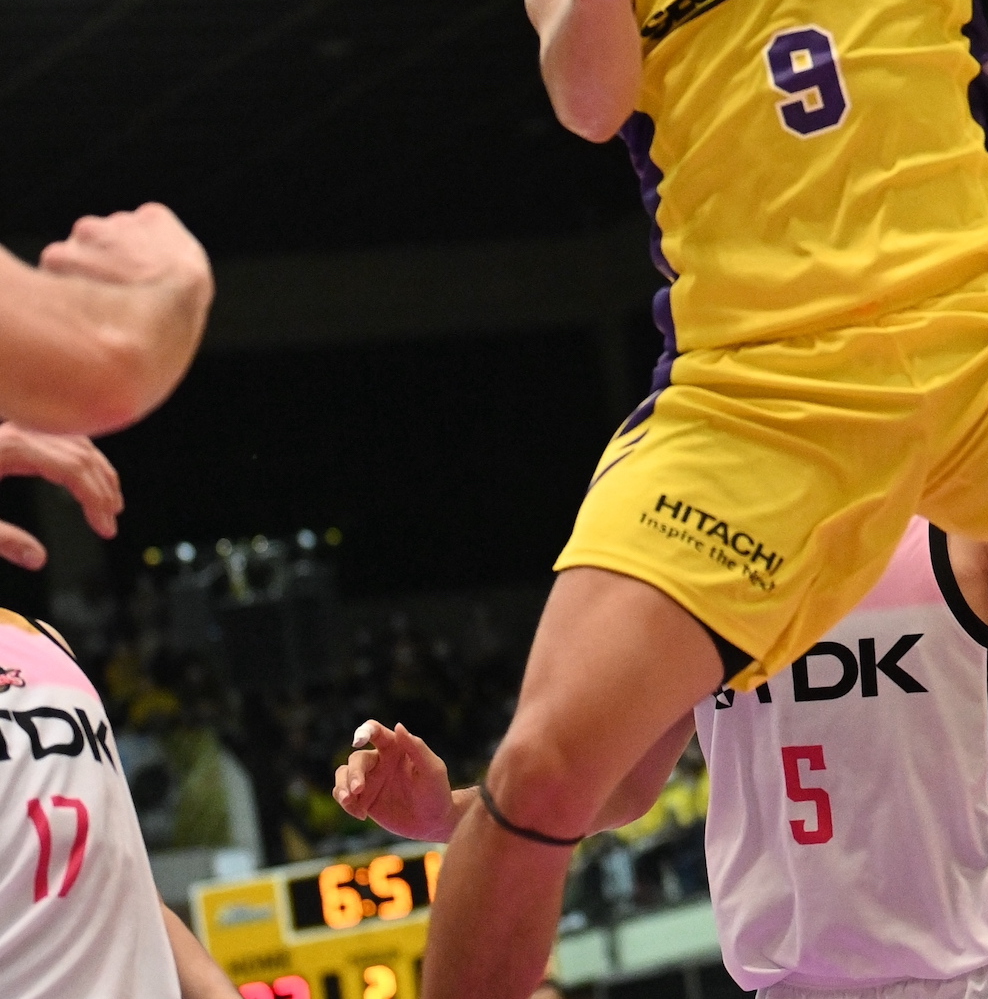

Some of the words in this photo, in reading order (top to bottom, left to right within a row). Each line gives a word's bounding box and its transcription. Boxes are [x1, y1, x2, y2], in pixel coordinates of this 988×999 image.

[761, 23, 851, 140] 9
[638, 512, 705, 553] Inspire
[708, 544, 738, 572] the
[654, 494, 784, 577] HITACHI
[755, 633, 930, 704] DK
[780, 744, 834, 846] 5
[27, 795, 90, 904] 17
